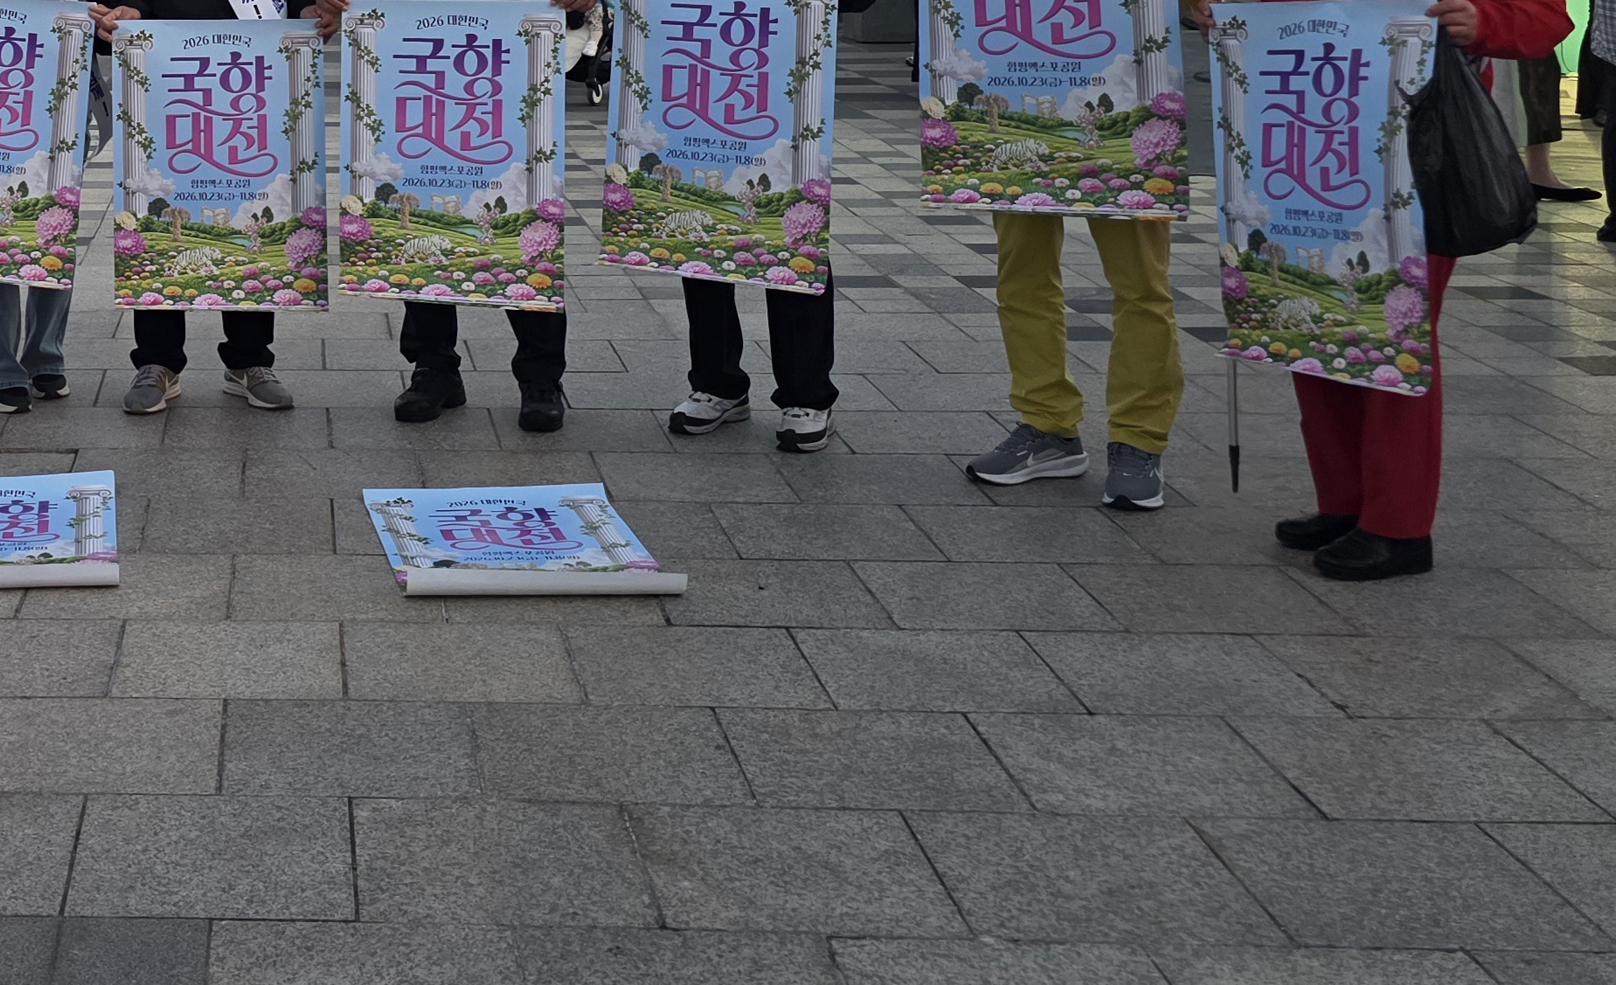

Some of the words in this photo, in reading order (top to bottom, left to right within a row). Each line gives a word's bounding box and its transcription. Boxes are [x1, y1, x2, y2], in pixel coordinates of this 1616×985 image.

[182, 35, 210, 50] 2026
[212, 34, 252, 48] 대한민국
[416, 16, 444, 30] 2026
[447, 15, 490, 30] 대한민국
[660, 0, 779, 72] 국향
[161, 50, 273, 116] 국향
[392, 33, 511, 102] 국향
[1258, 42, 1371, 129] 국향
[394, 97, 514, 166] 대전
[661, 64, 779, 141] 대전
[165, 112, 279, 178] 대전
[1260, 121, 1371, 211] 대전
[428, 506, 558, 529] 국향
[439, 527, 583, 551] 대전
